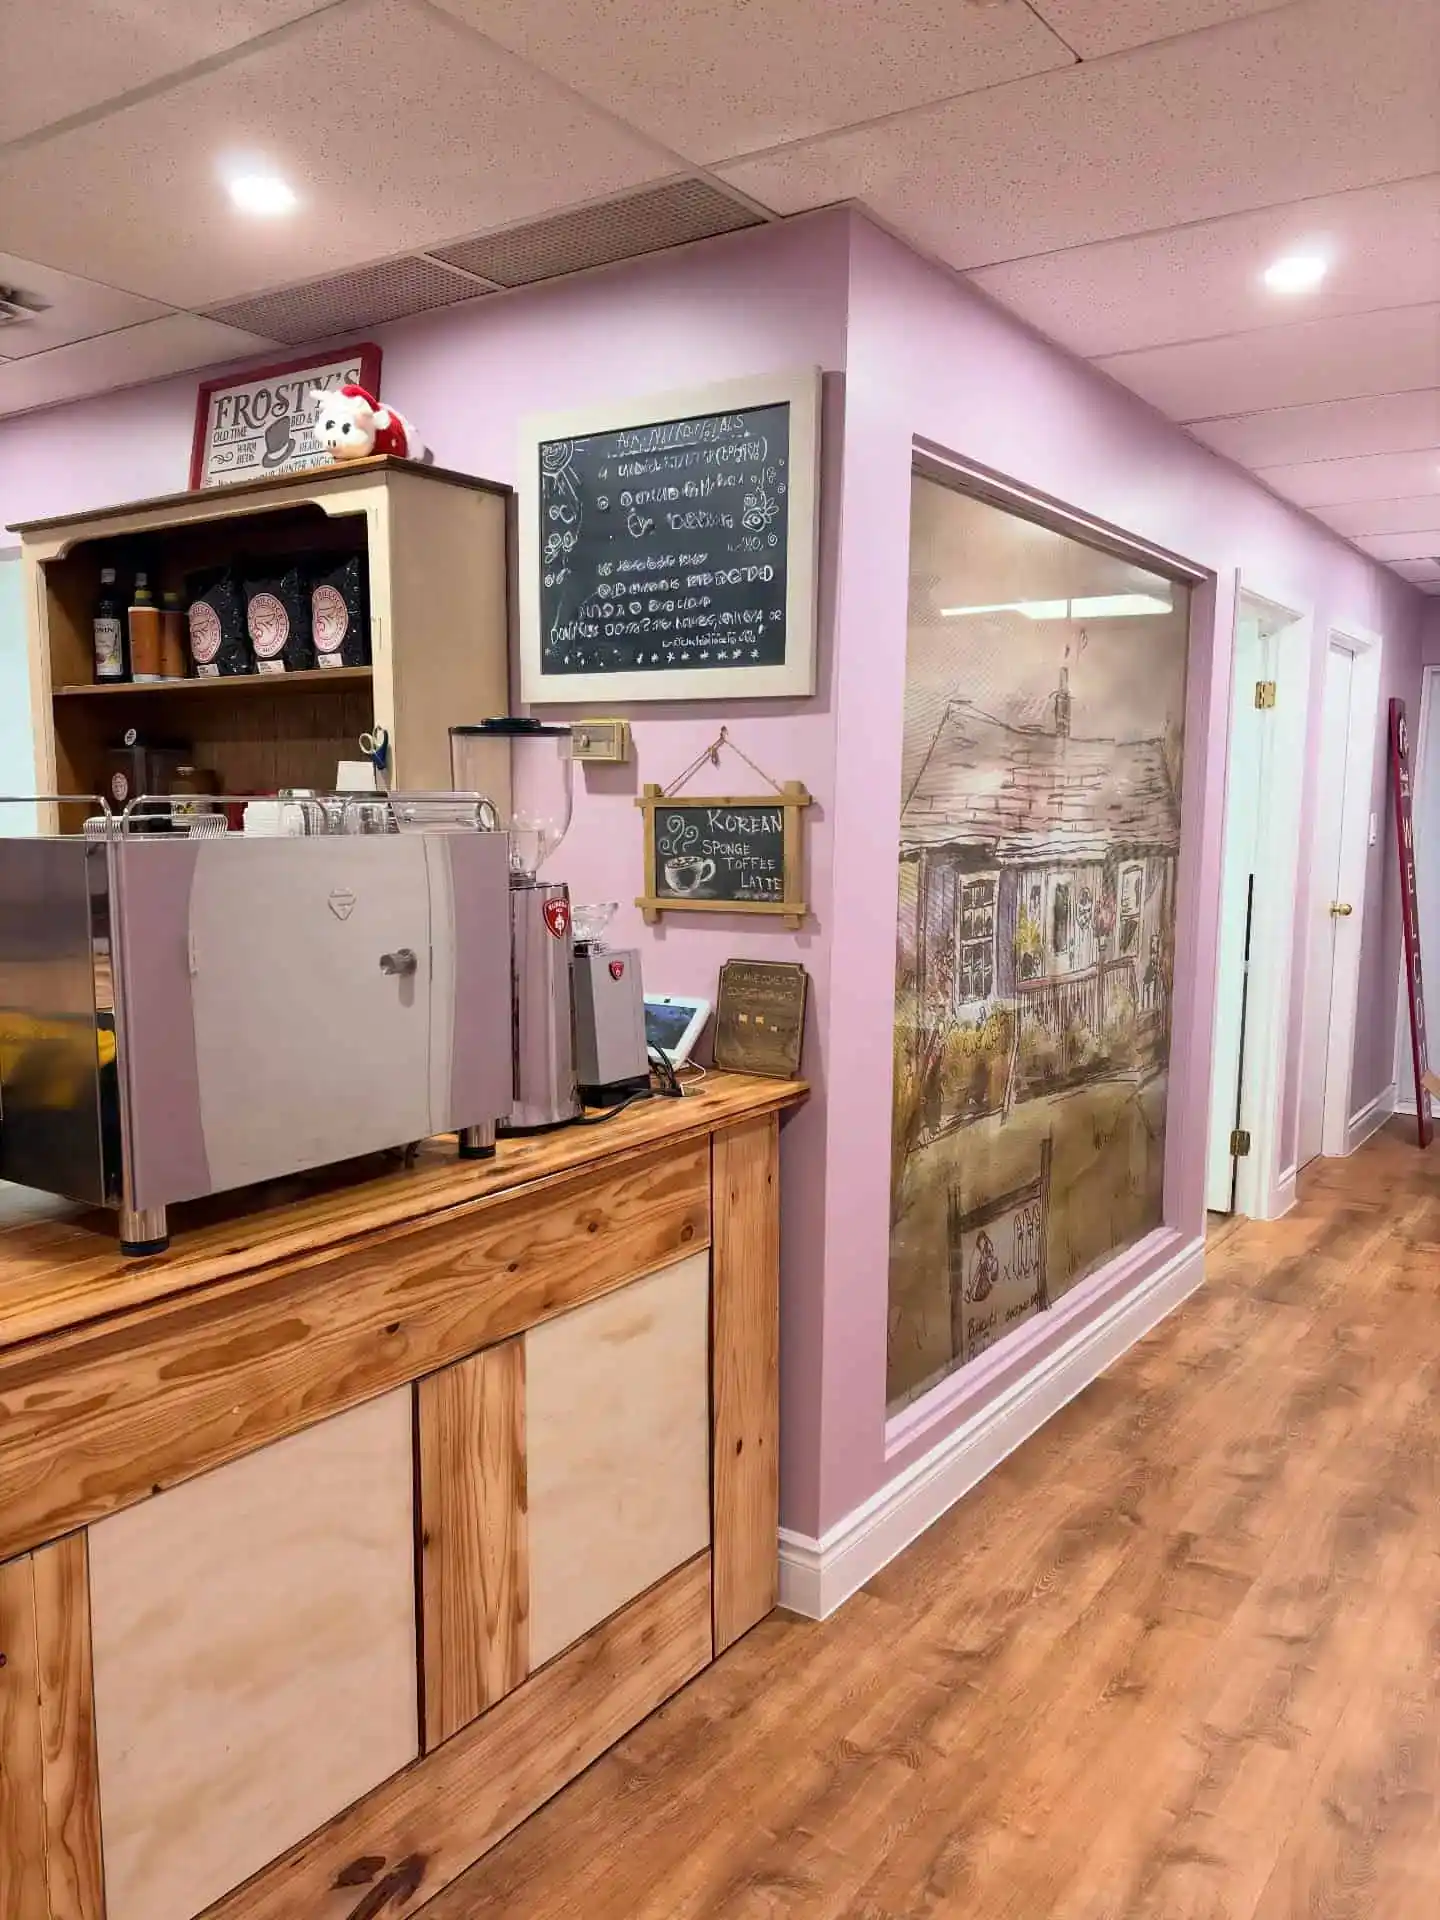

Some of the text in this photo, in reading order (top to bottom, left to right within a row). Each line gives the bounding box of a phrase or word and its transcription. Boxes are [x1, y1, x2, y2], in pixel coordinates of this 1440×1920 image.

[706, 808, 782, 836] KOREAN
[702, 839, 751, 857] SPONGE
[720, 856, 776, 872] TOFFEE
[740, 871, 783, 891] LATTE
